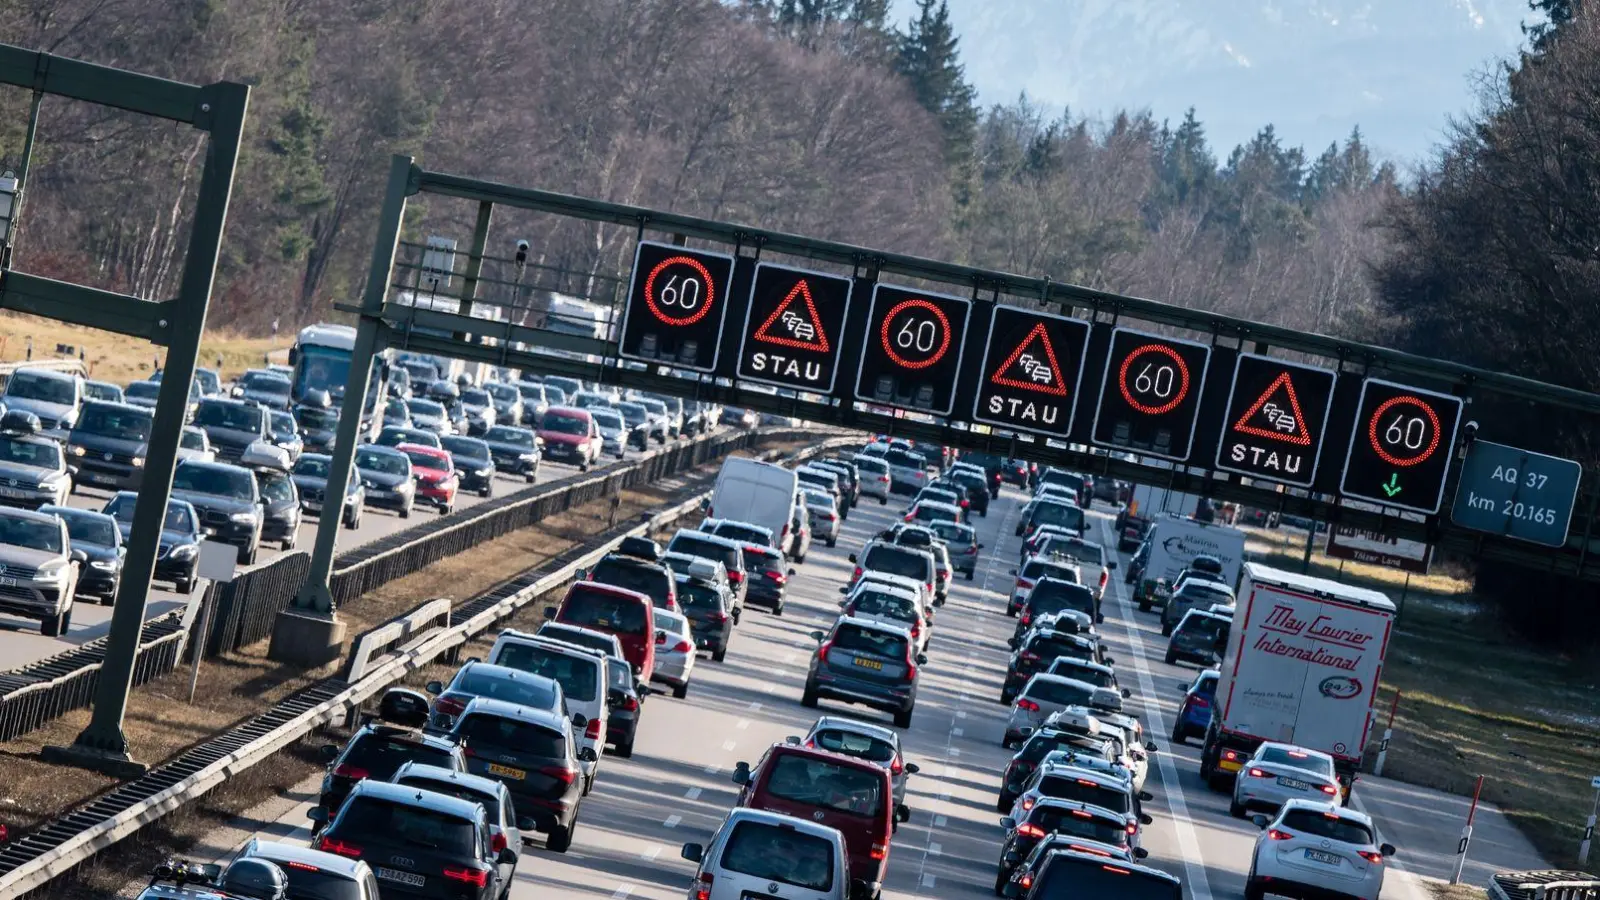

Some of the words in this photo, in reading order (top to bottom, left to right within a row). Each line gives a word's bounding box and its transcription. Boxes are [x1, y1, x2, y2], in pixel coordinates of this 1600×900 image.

[662, 275, 698, 309] 60
[898, 318, 935, 351] 60
[752, 353, 820, 380] STAU
[1136, 363, 1173, 397] 60
[989, 395, 1058, 424] STAU
[1386, 415, 1424, 449] 60
[1231, 443, 1301, 473] STAU
[1491, 465, 1517, 484] AQ
[1526, 472, 1548, 490] 37
[1468, 492, 1495, 512] km
[1502, 500, 1556, 525] 20.165
[1261, 604, 1307, 635] May
[1307, 615, 1373, 645] Courier
[1253, 632, 1362, 671] International
